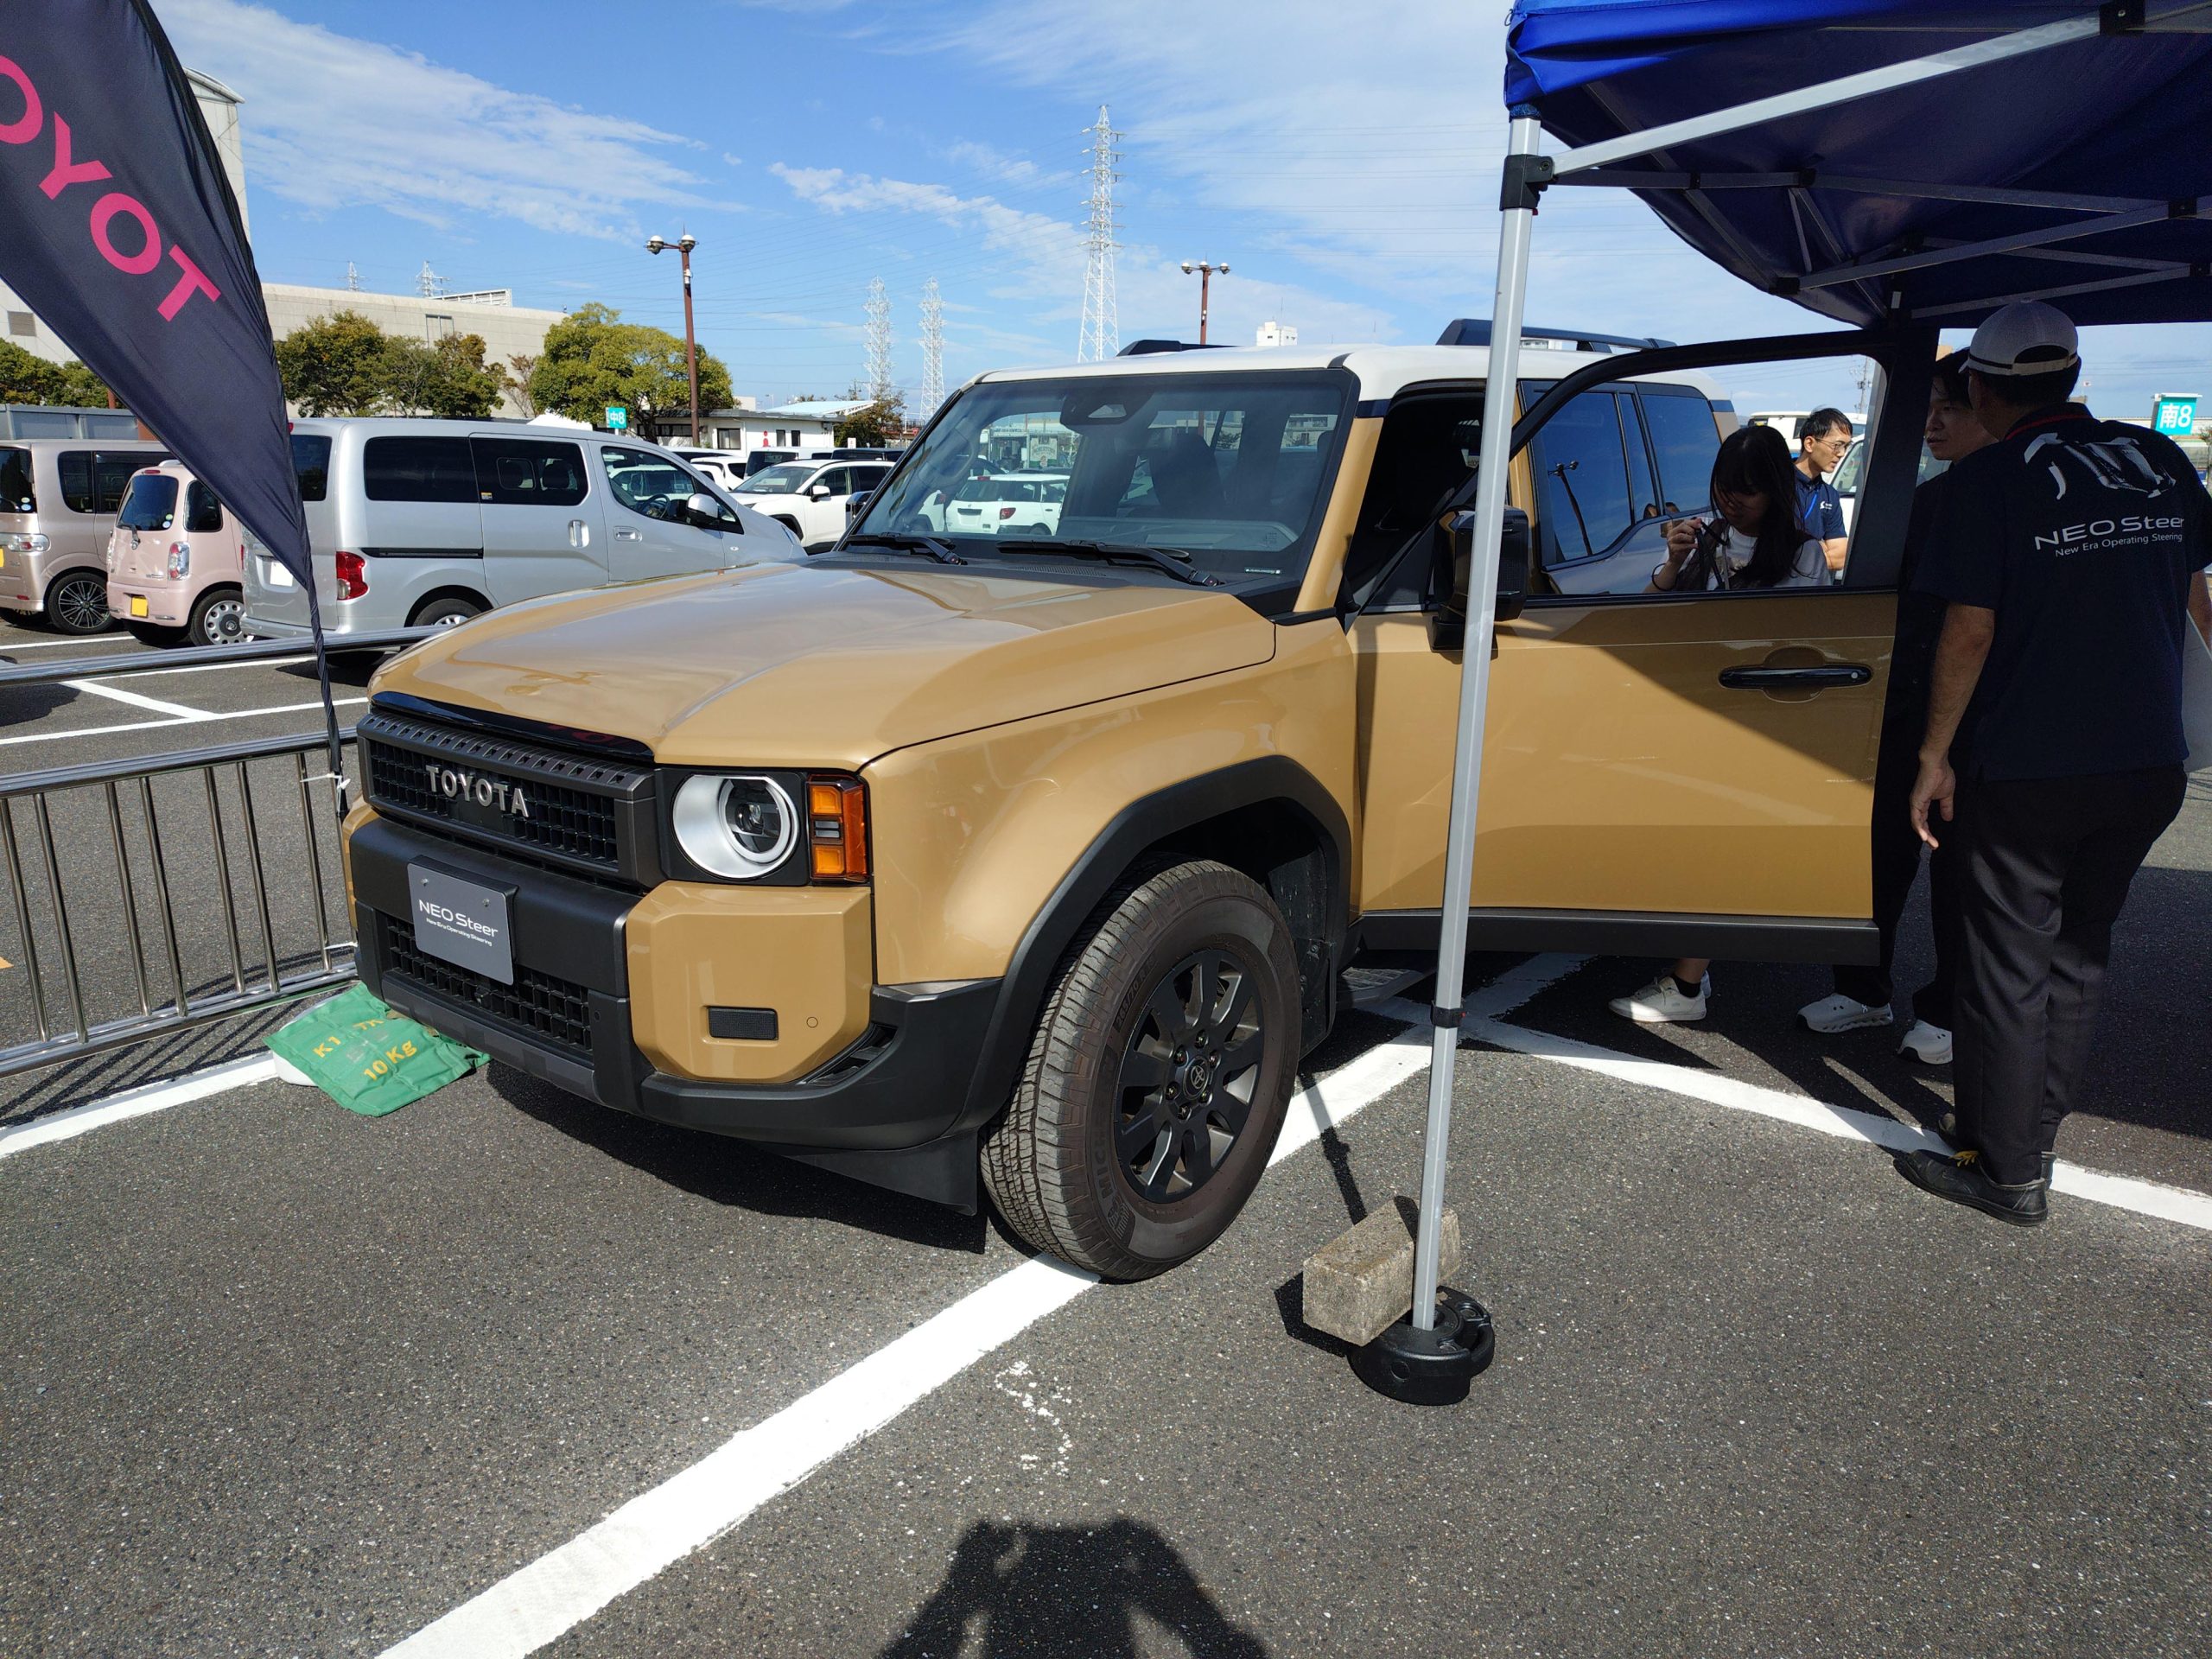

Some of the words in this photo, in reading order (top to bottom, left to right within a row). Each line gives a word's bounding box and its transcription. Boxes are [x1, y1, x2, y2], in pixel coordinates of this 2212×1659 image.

[609, 410, 626, 425] 中8
[2159, 403, 2192, 429] 南8
[2034, 519, 2115, 550] NEO
[2120, 516, 2184, 532] Steer
[2055, 545, 2079, 557] New
[2082, 541, 2099, 551] Era
[2101, 535, 2149, 548] Operating
[2152, 531, 2183, 543] Steering
[425, 764, 530, 818] TOYOTA
[418, 899, 454, 922] NEO
[455, 912, 499, 938] Steer
